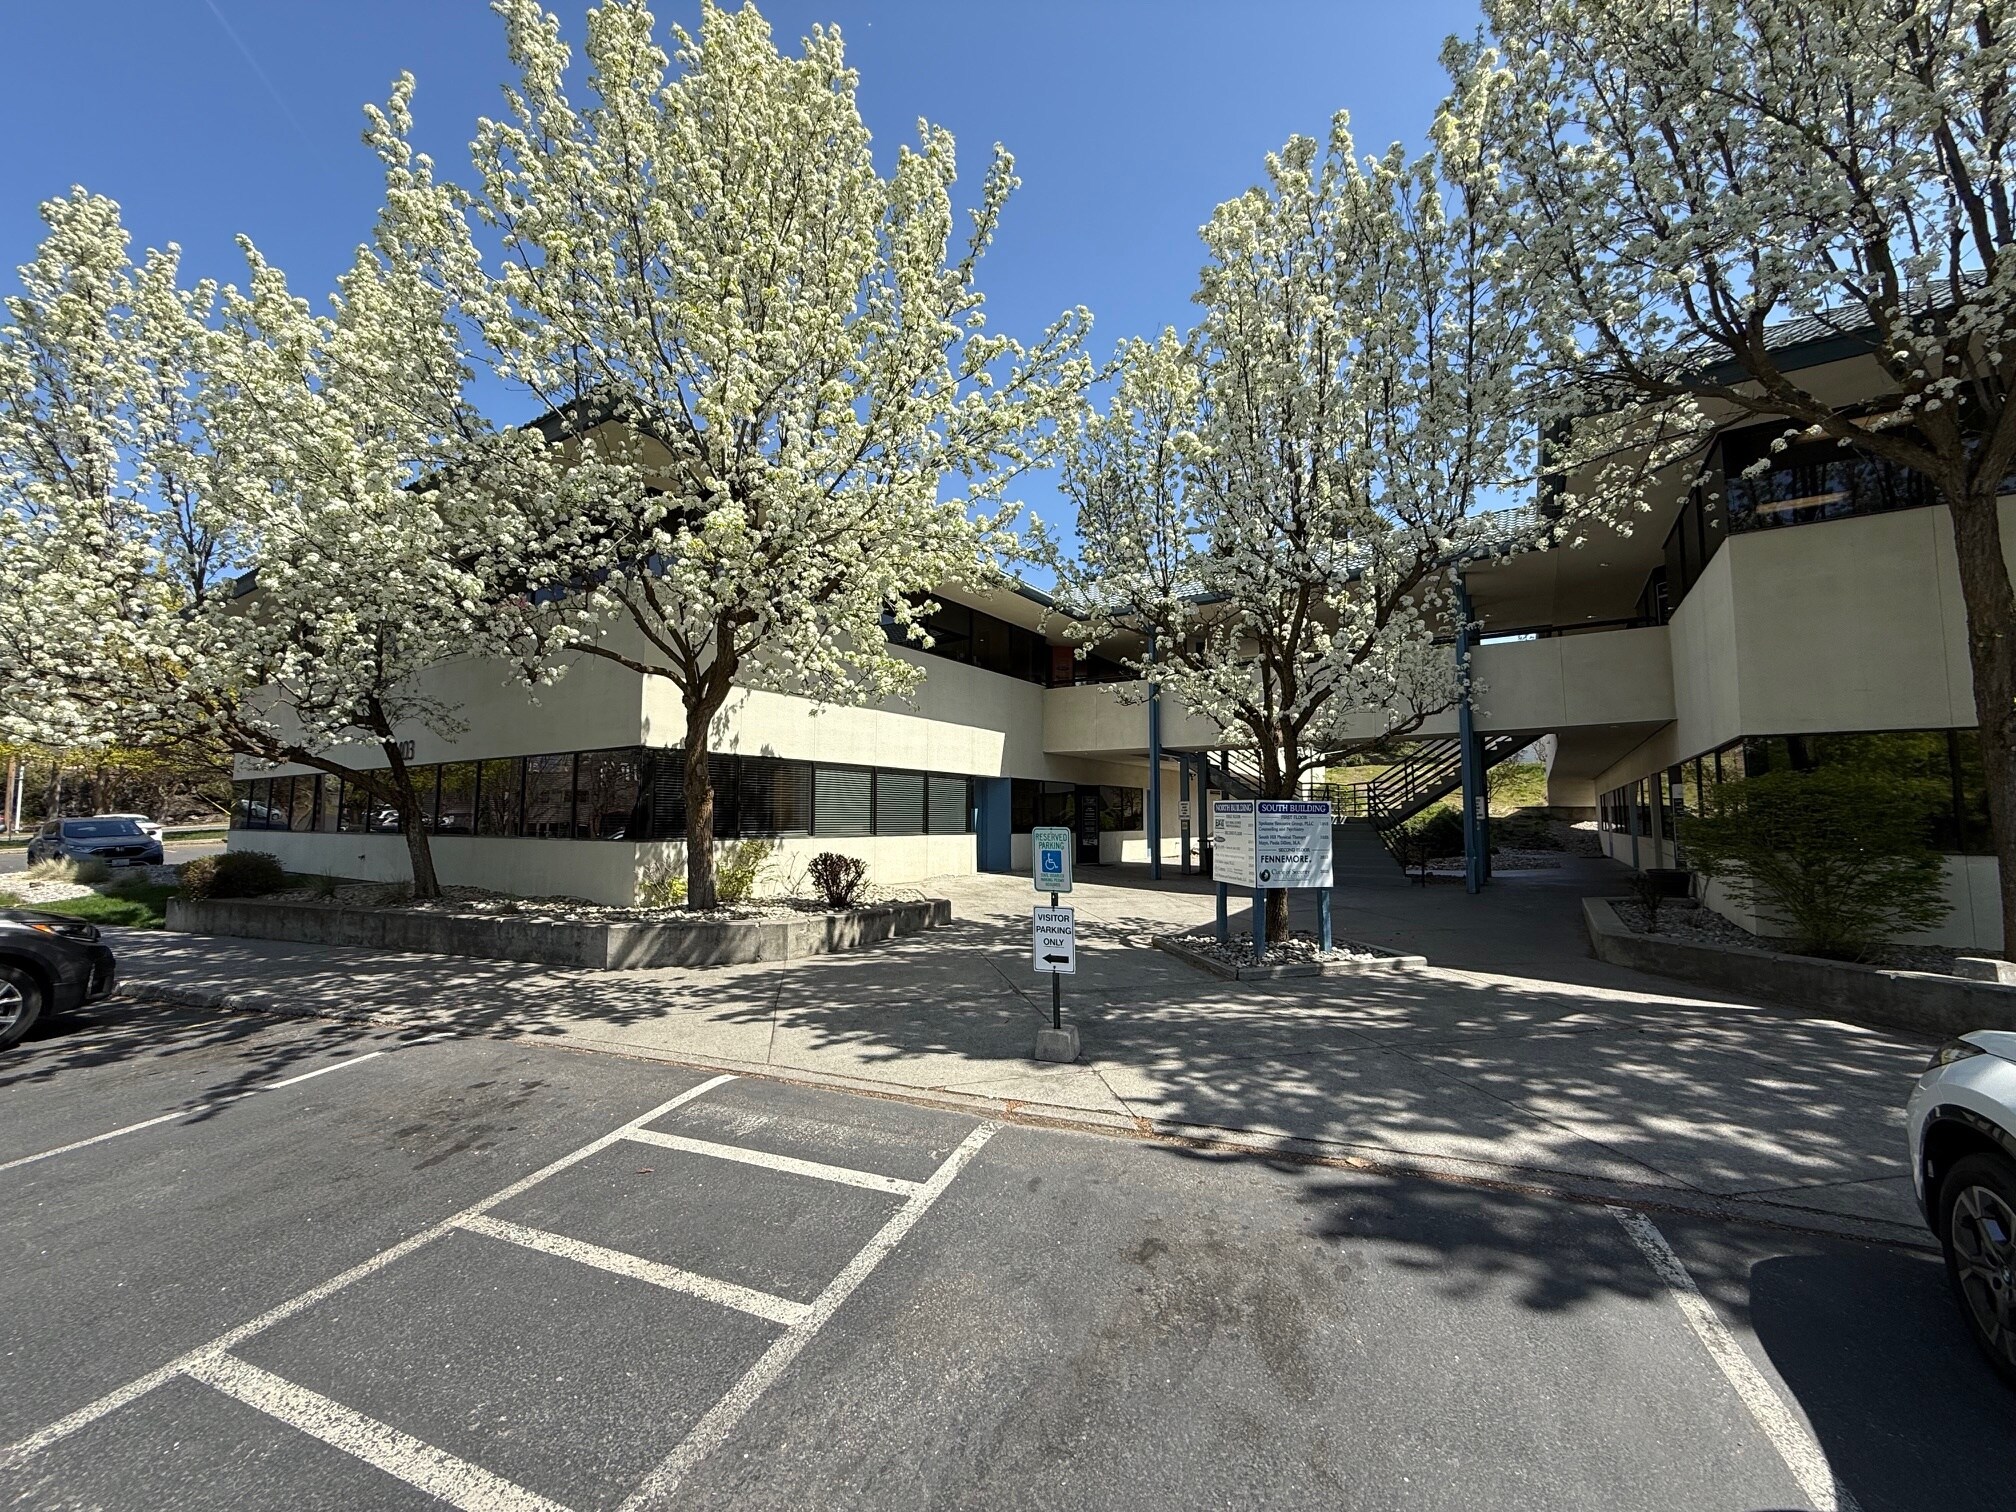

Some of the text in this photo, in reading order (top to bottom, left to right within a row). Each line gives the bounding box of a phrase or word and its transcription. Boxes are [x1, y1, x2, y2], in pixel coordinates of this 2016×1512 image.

[1215, 804, 1252, 812] NORTH BUILDING
[1261, 804, 1288, 812] SOUTH
[1035, 833, 1067, 841] RESERVED
[1038, 842, 1064, 850] PARKING
[1037, 914, 1070, 922] VISITOR
[1036, 926, 1071, 934] PARKING
[1043, 938, 1064, 946] ONLY
